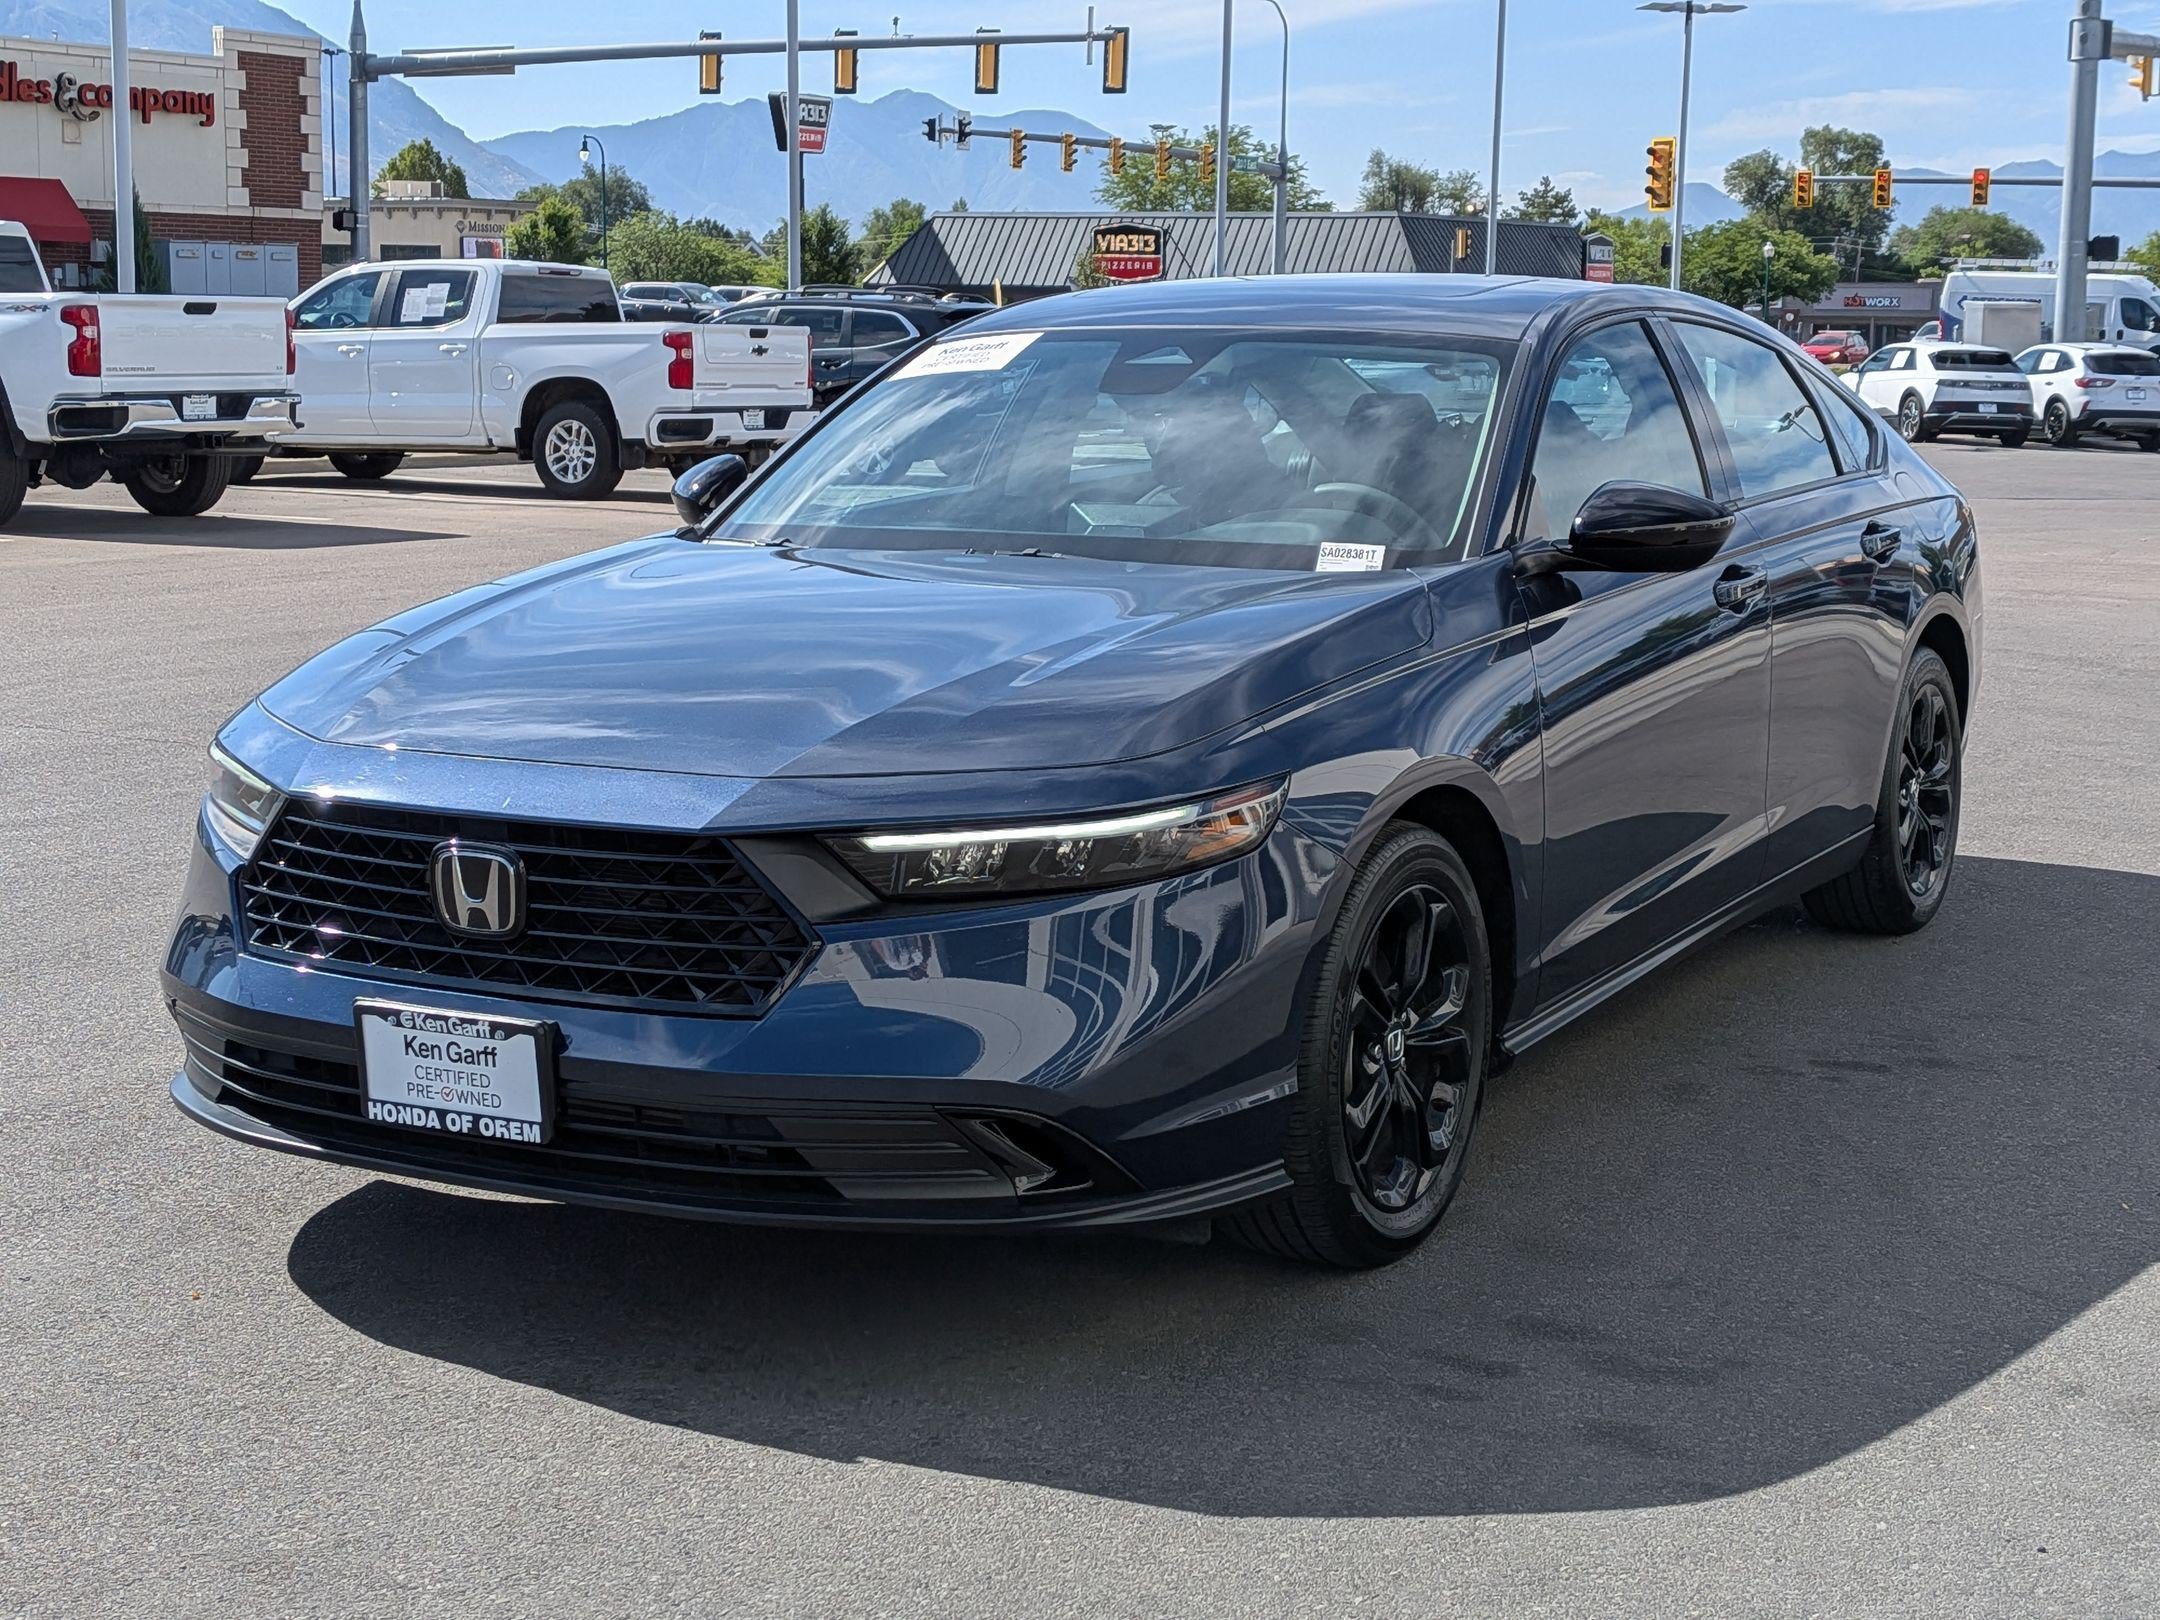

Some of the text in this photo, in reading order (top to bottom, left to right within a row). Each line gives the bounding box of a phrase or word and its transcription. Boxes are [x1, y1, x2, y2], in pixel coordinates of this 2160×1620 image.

[799, 103, 827, 122] A313
[1096, 233, 1156, 252] VIA313
[1844, 294, 1900, 307] HOTWORX
[1320, 547, 1377, 561] SA028381T
[413, 1012, 491, 1039] Ken Garff
[403, 1034, 498, 1068] Ken Garff
[414, 1064, 491, 1089] CERTIFIED
[368, 1101, 541, 1144] HONDA OF OREM
